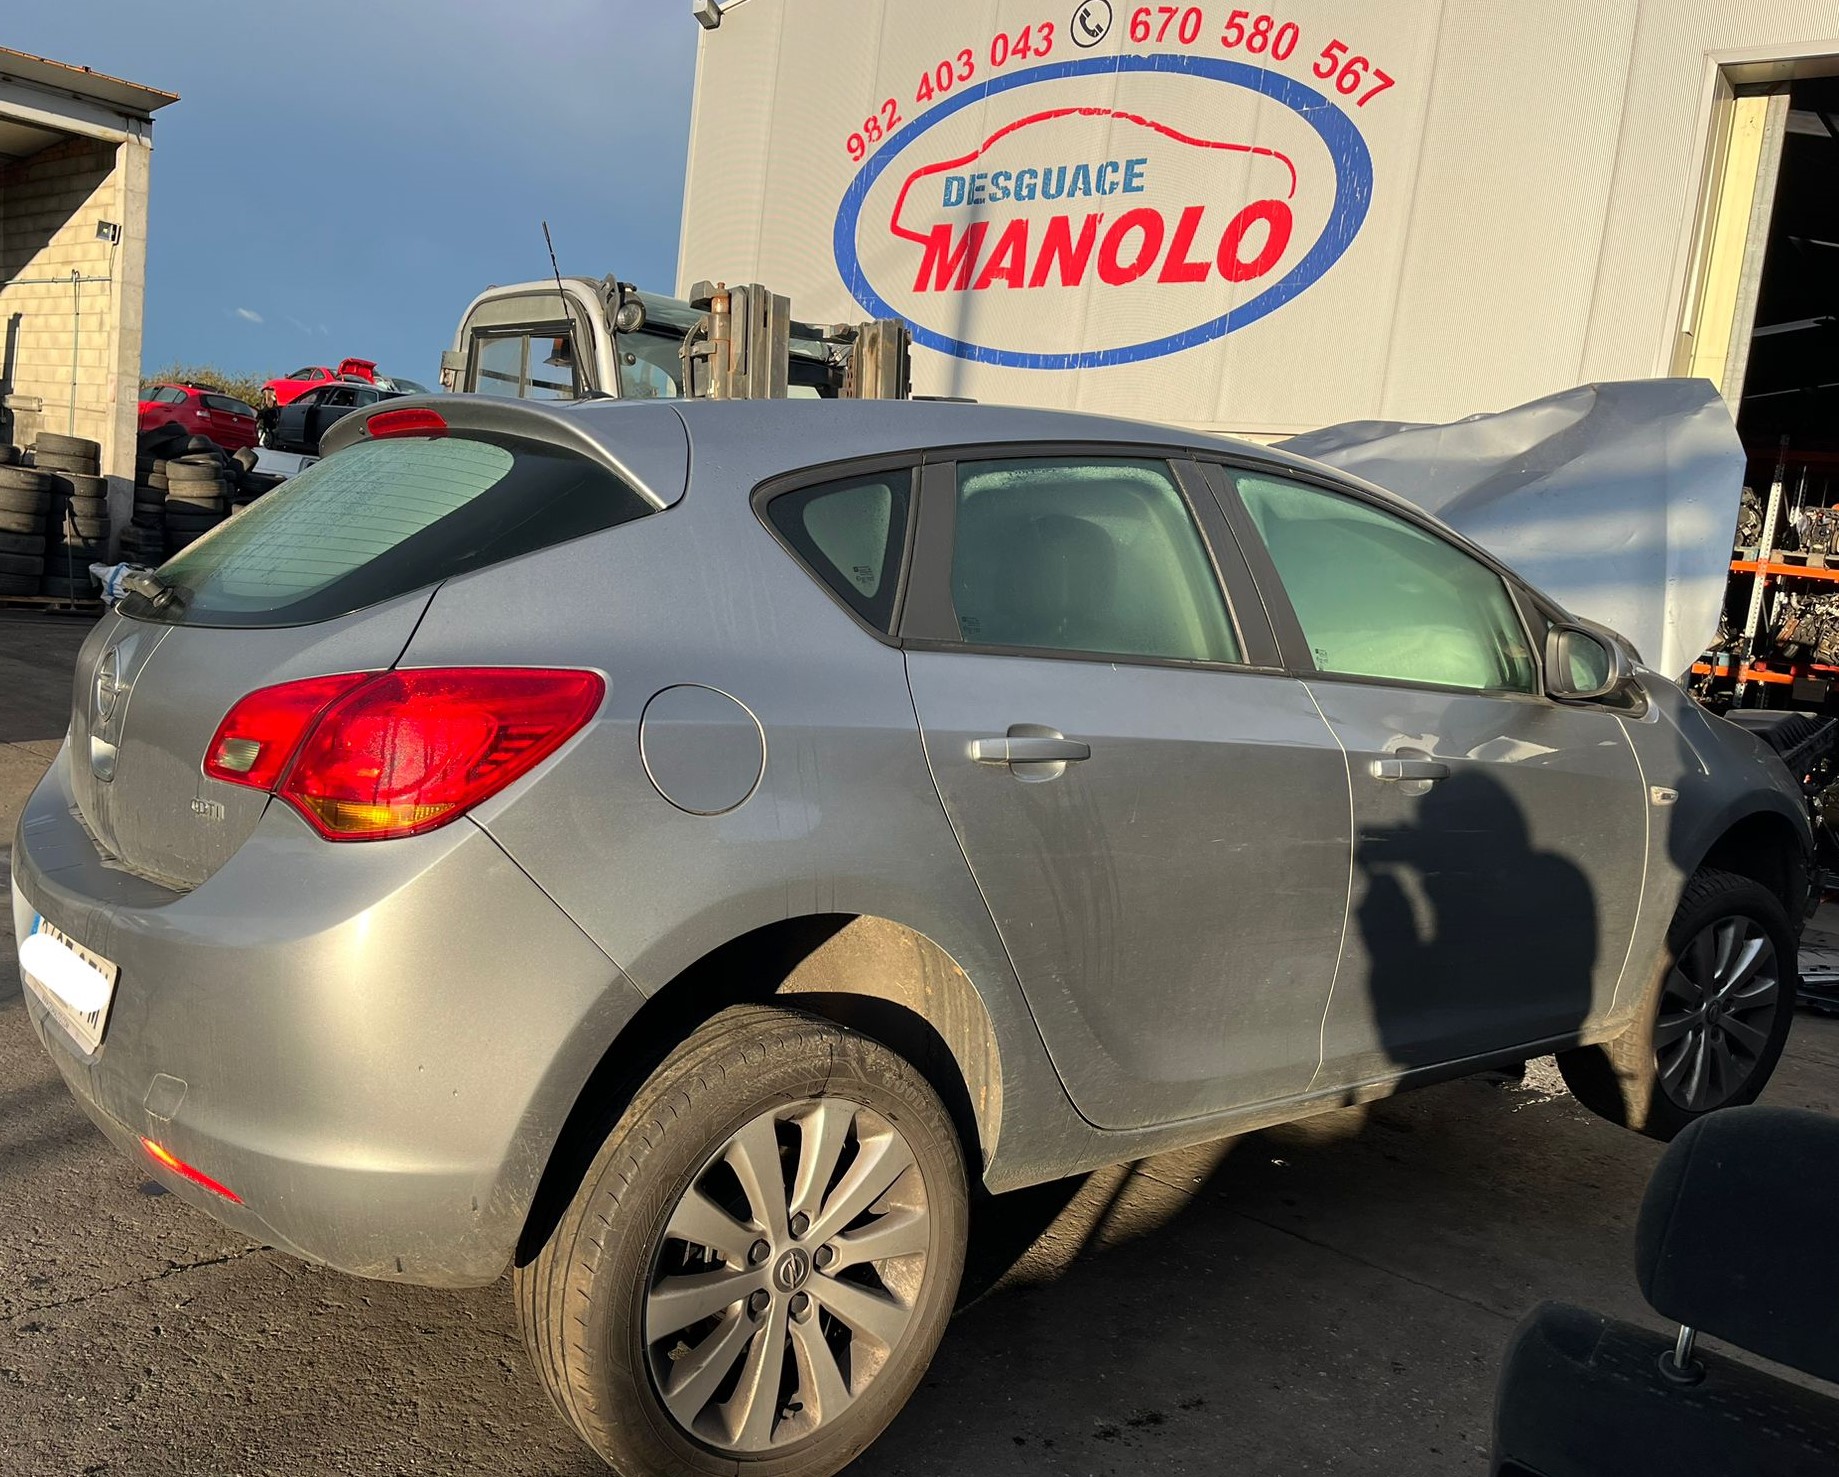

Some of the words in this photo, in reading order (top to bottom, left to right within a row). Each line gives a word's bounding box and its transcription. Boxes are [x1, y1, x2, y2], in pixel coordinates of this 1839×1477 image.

[847, 98, 902, 162] 982
[916, 49, 975, 102] 403
[990, 22, 1055, 67] 043
[1130, 6, 1203, 45] 670
[1221, 10, 1300, 61] 580
[1313, 39, 1395, 107] 567
[942, 158, 1147, 207] DESGUACE
[912, 199, 1294, 293] MANOLO
